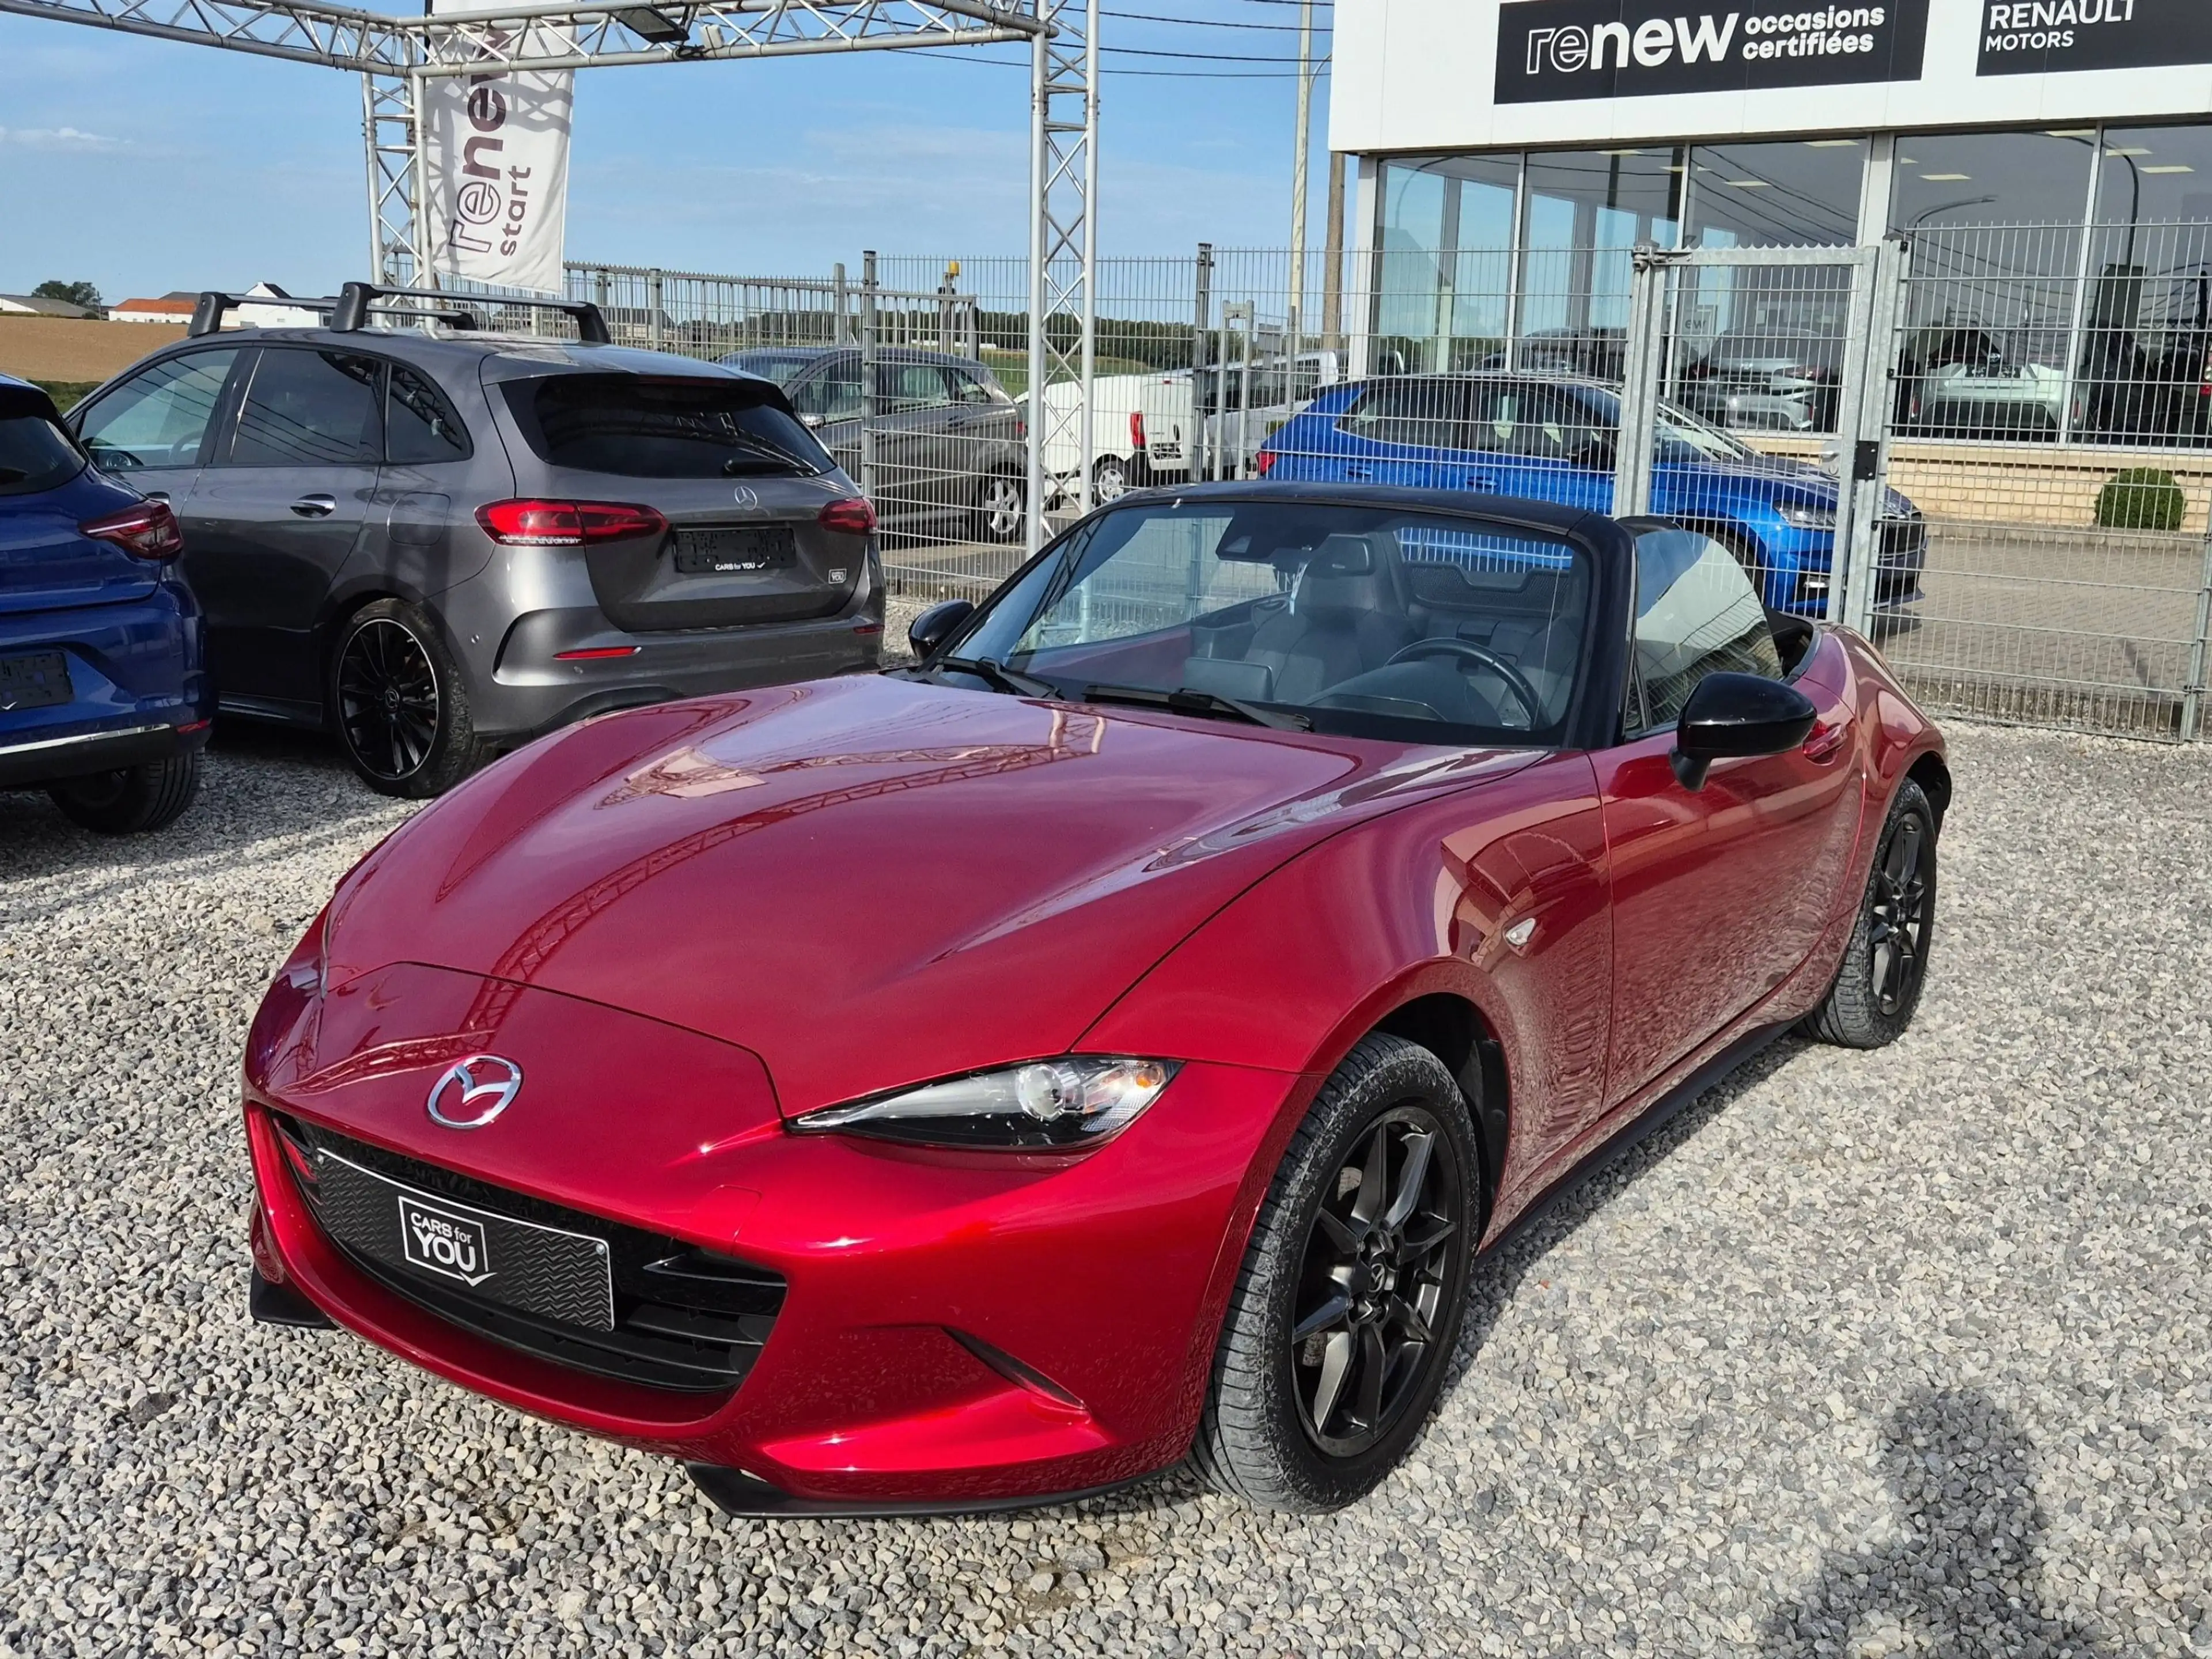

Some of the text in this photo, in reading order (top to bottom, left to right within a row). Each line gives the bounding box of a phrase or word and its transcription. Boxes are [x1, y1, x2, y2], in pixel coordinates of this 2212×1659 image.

[1745, 5, 1885, 35] occasions
[1990, 0, 2134, 30] RENAULT
[1527, 13, 1740, 75] renew
[1742, 31, 1874, 60] certifiées
[1985, 31, 2074, 52] MOTORS
[500, 165, 531, 256] start
[410, 1212, 473, 1244] CARS for
[412, 1225, 477, 1272] YOU
